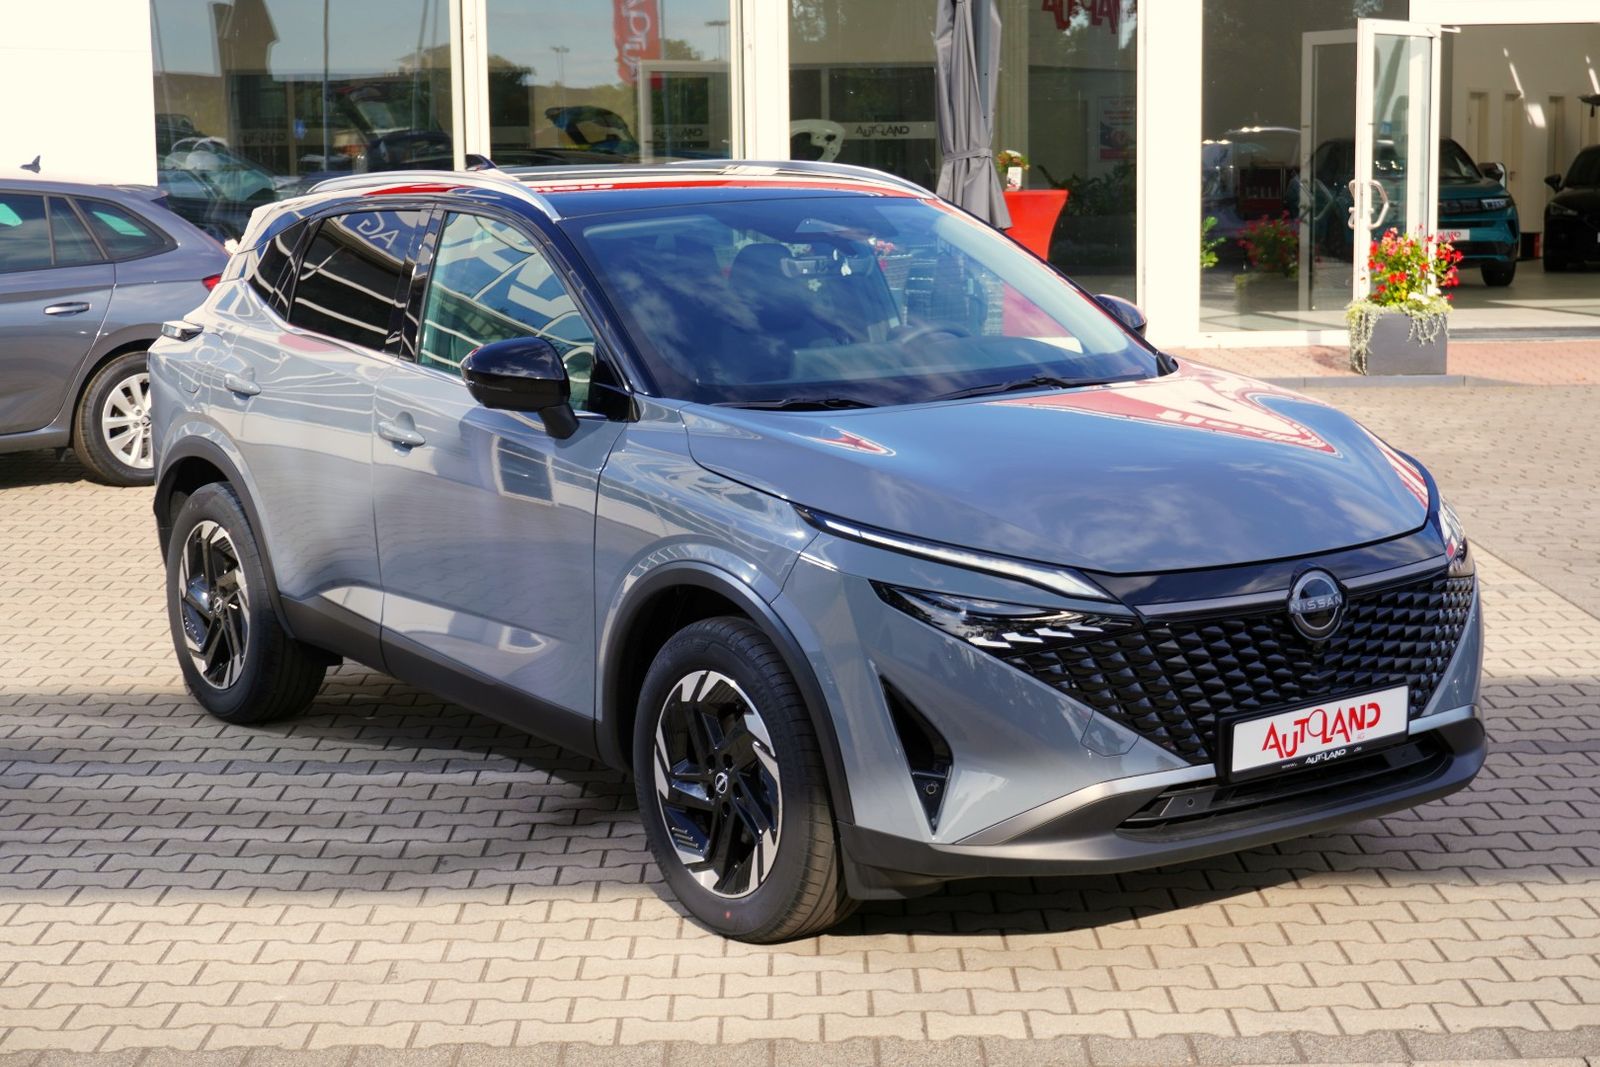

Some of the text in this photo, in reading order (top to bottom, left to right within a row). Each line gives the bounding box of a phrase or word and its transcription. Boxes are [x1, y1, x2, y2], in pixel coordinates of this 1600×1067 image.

[1290, 596, 1342, 612] NISSAN
[1261, 702, 1381, 758] AUTOLAND
[1305, 748, 1346, 764] AUTOLAND
